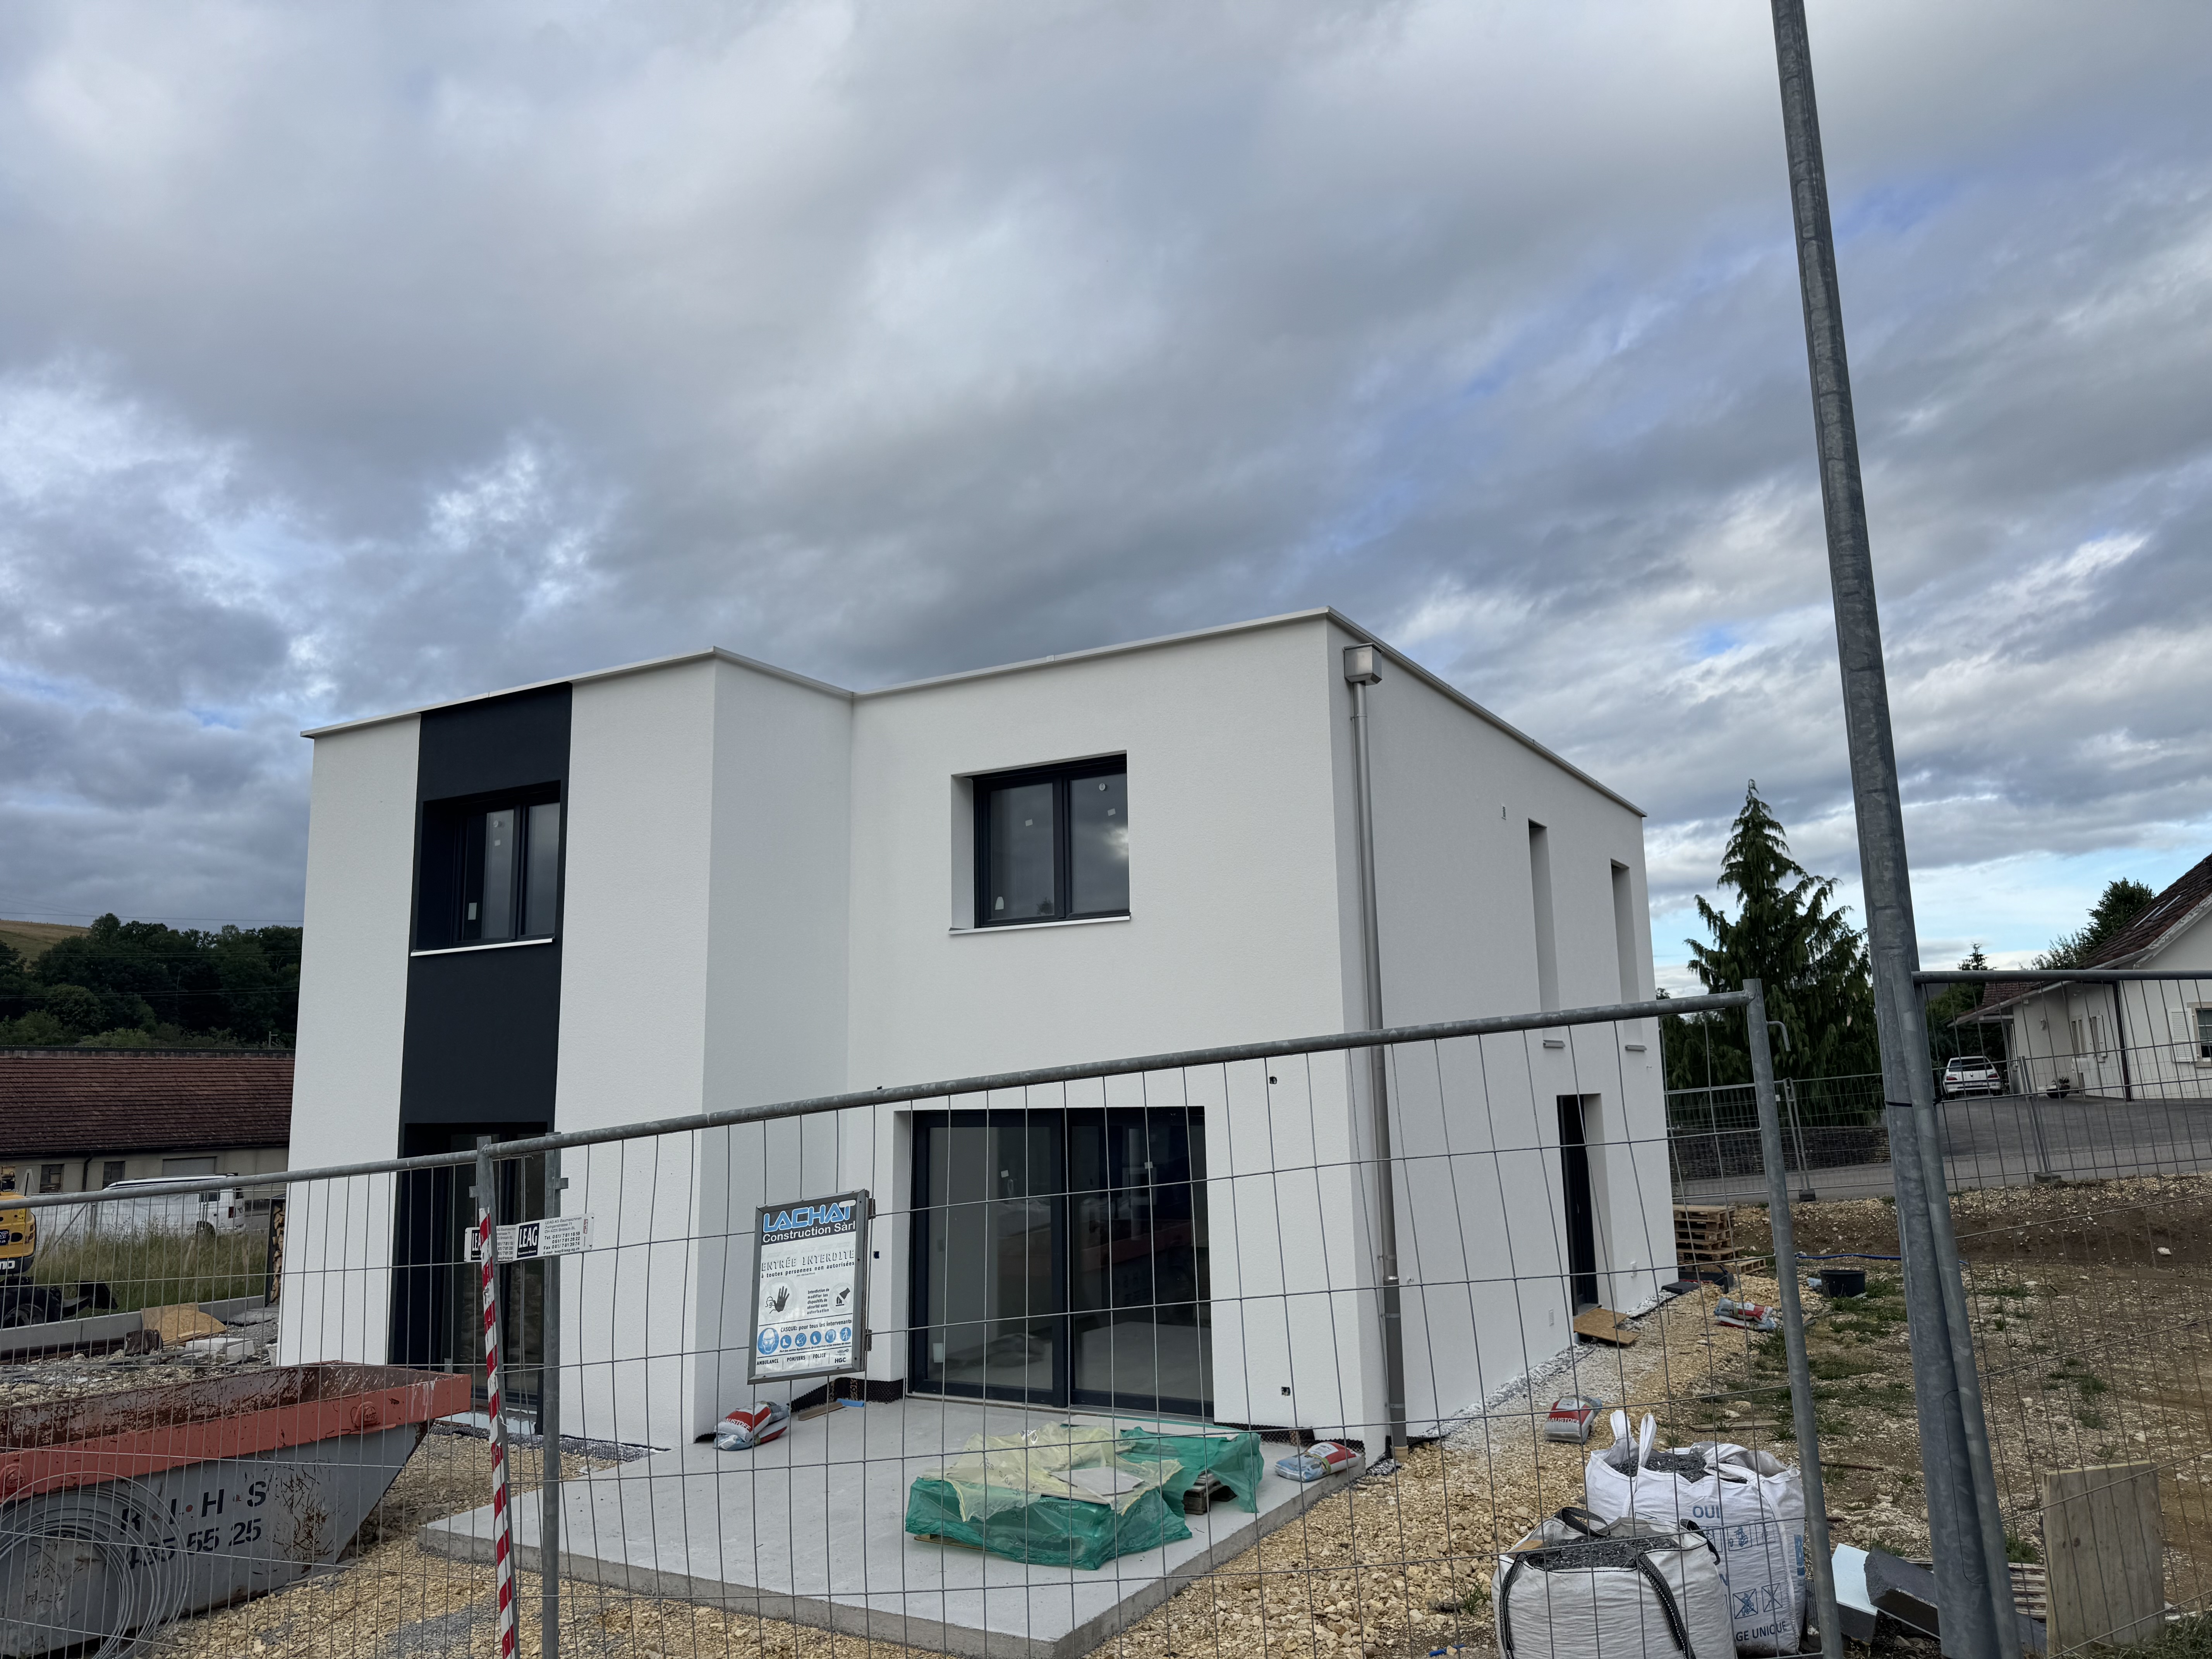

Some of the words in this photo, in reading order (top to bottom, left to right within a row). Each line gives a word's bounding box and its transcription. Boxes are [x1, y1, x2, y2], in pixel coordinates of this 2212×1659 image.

[763, 1200, 856, 1233] LACHAT
[519, 1226, 538, 1248] LEAG
[763, 1226, 831, 1243] Construction
[834, 1220, 855, 1232] Sàrl
[761, 1257, 797, 1271] ENTRÉE
[802, 1250, 854, 1266] INTERDITE
[785, 1267, 812, 1276] personnes
[826, 1261, 854, 1269] autorisées
[1693, 1505, 1720, 1518] OUI
[187, 1527, 220, 1556] 55
[228, 1518, 261, 1547] 25
[1752, 1621, 1787, 1639] UNIQUE
